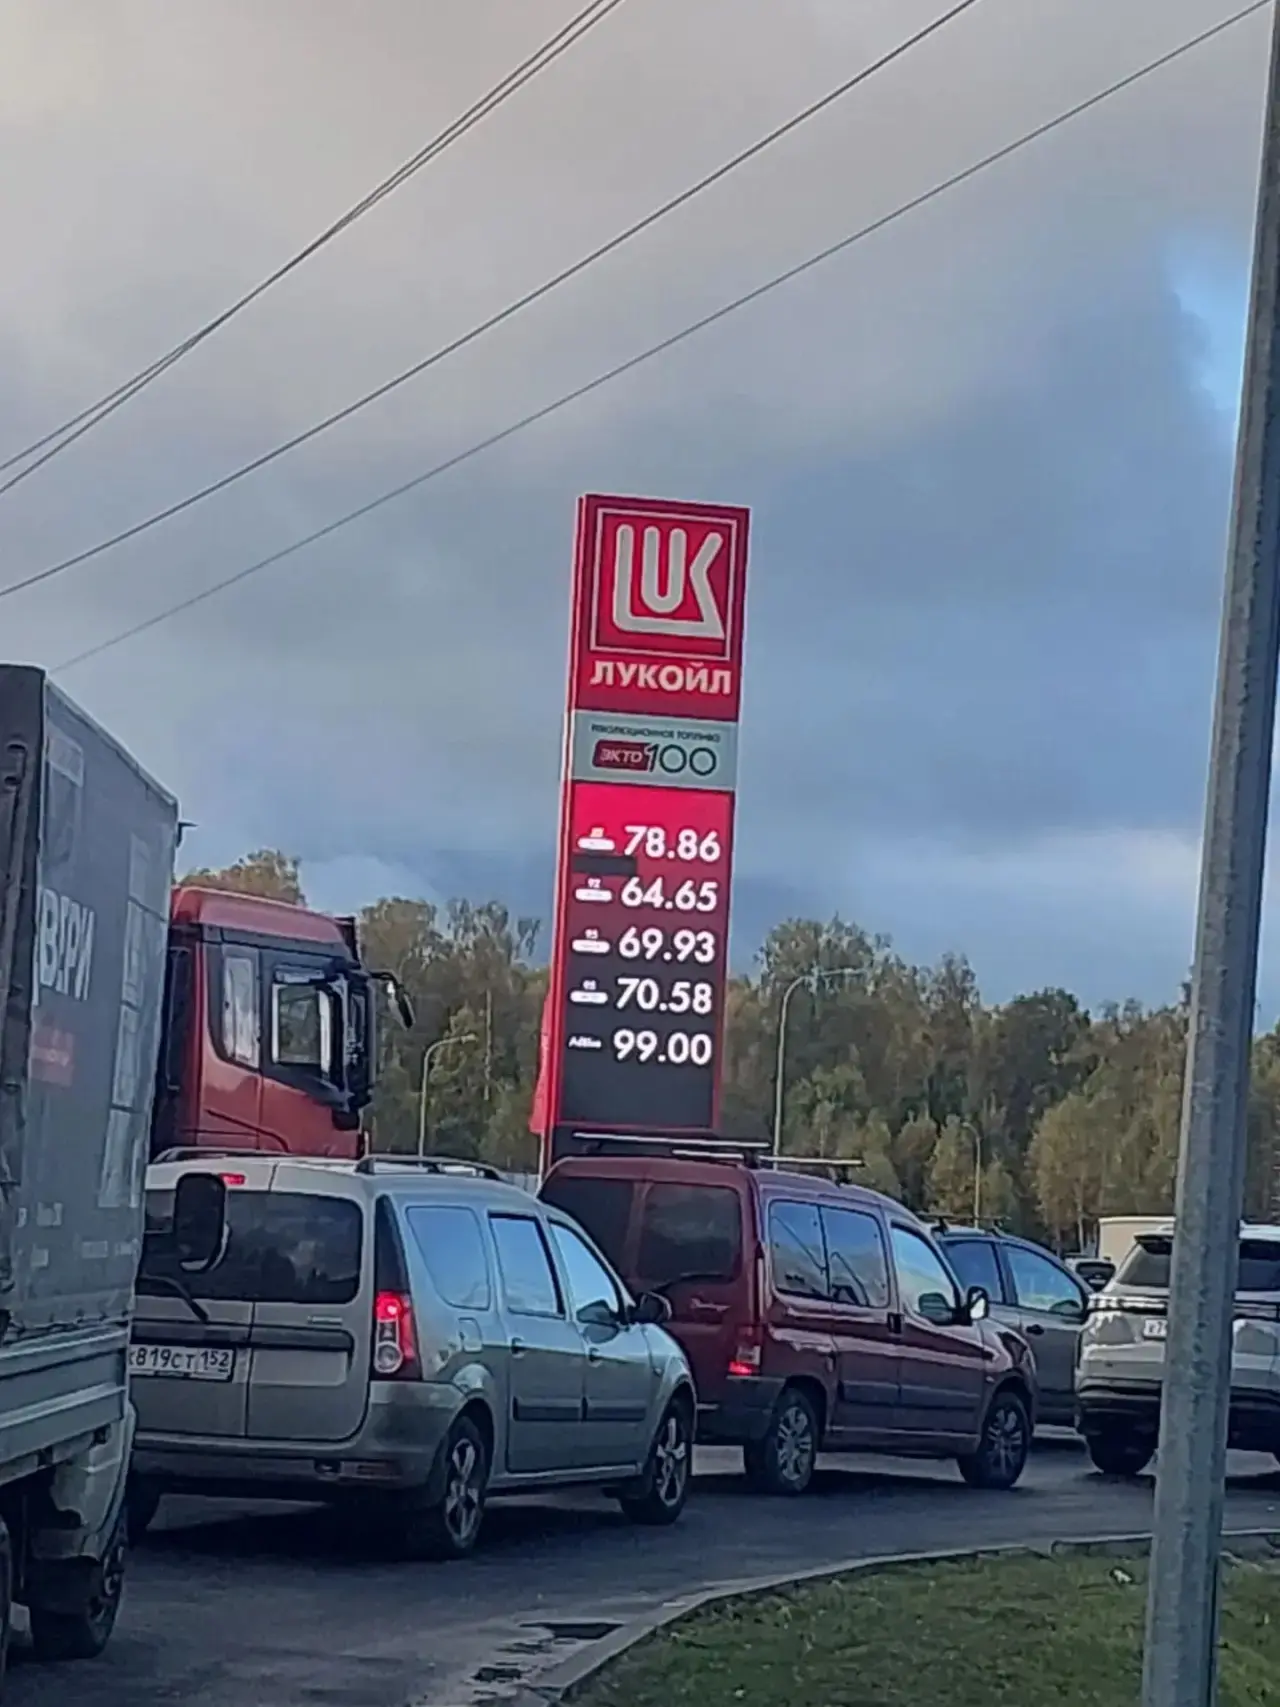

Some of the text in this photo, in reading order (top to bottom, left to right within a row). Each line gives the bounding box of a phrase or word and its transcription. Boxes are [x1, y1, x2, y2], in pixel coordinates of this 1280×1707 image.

[612, 524, 725, 640] LUK
[590, 660, 732, 694] ЛУКОЙЛ
[600, 743, 717, 776] ЭКТО 100
[624, 825, 720, 861] 78.86
[621, 876, 718, 911] 64.65
[32, 886, 95, 1002] ВЕРИ
[619, 926, 715, 962] 69.93
[616, 978, 712, 1014] 70.58
[614, 1029, 712, 1065] 99.00
[201, 1350, 229, 1367] 152
